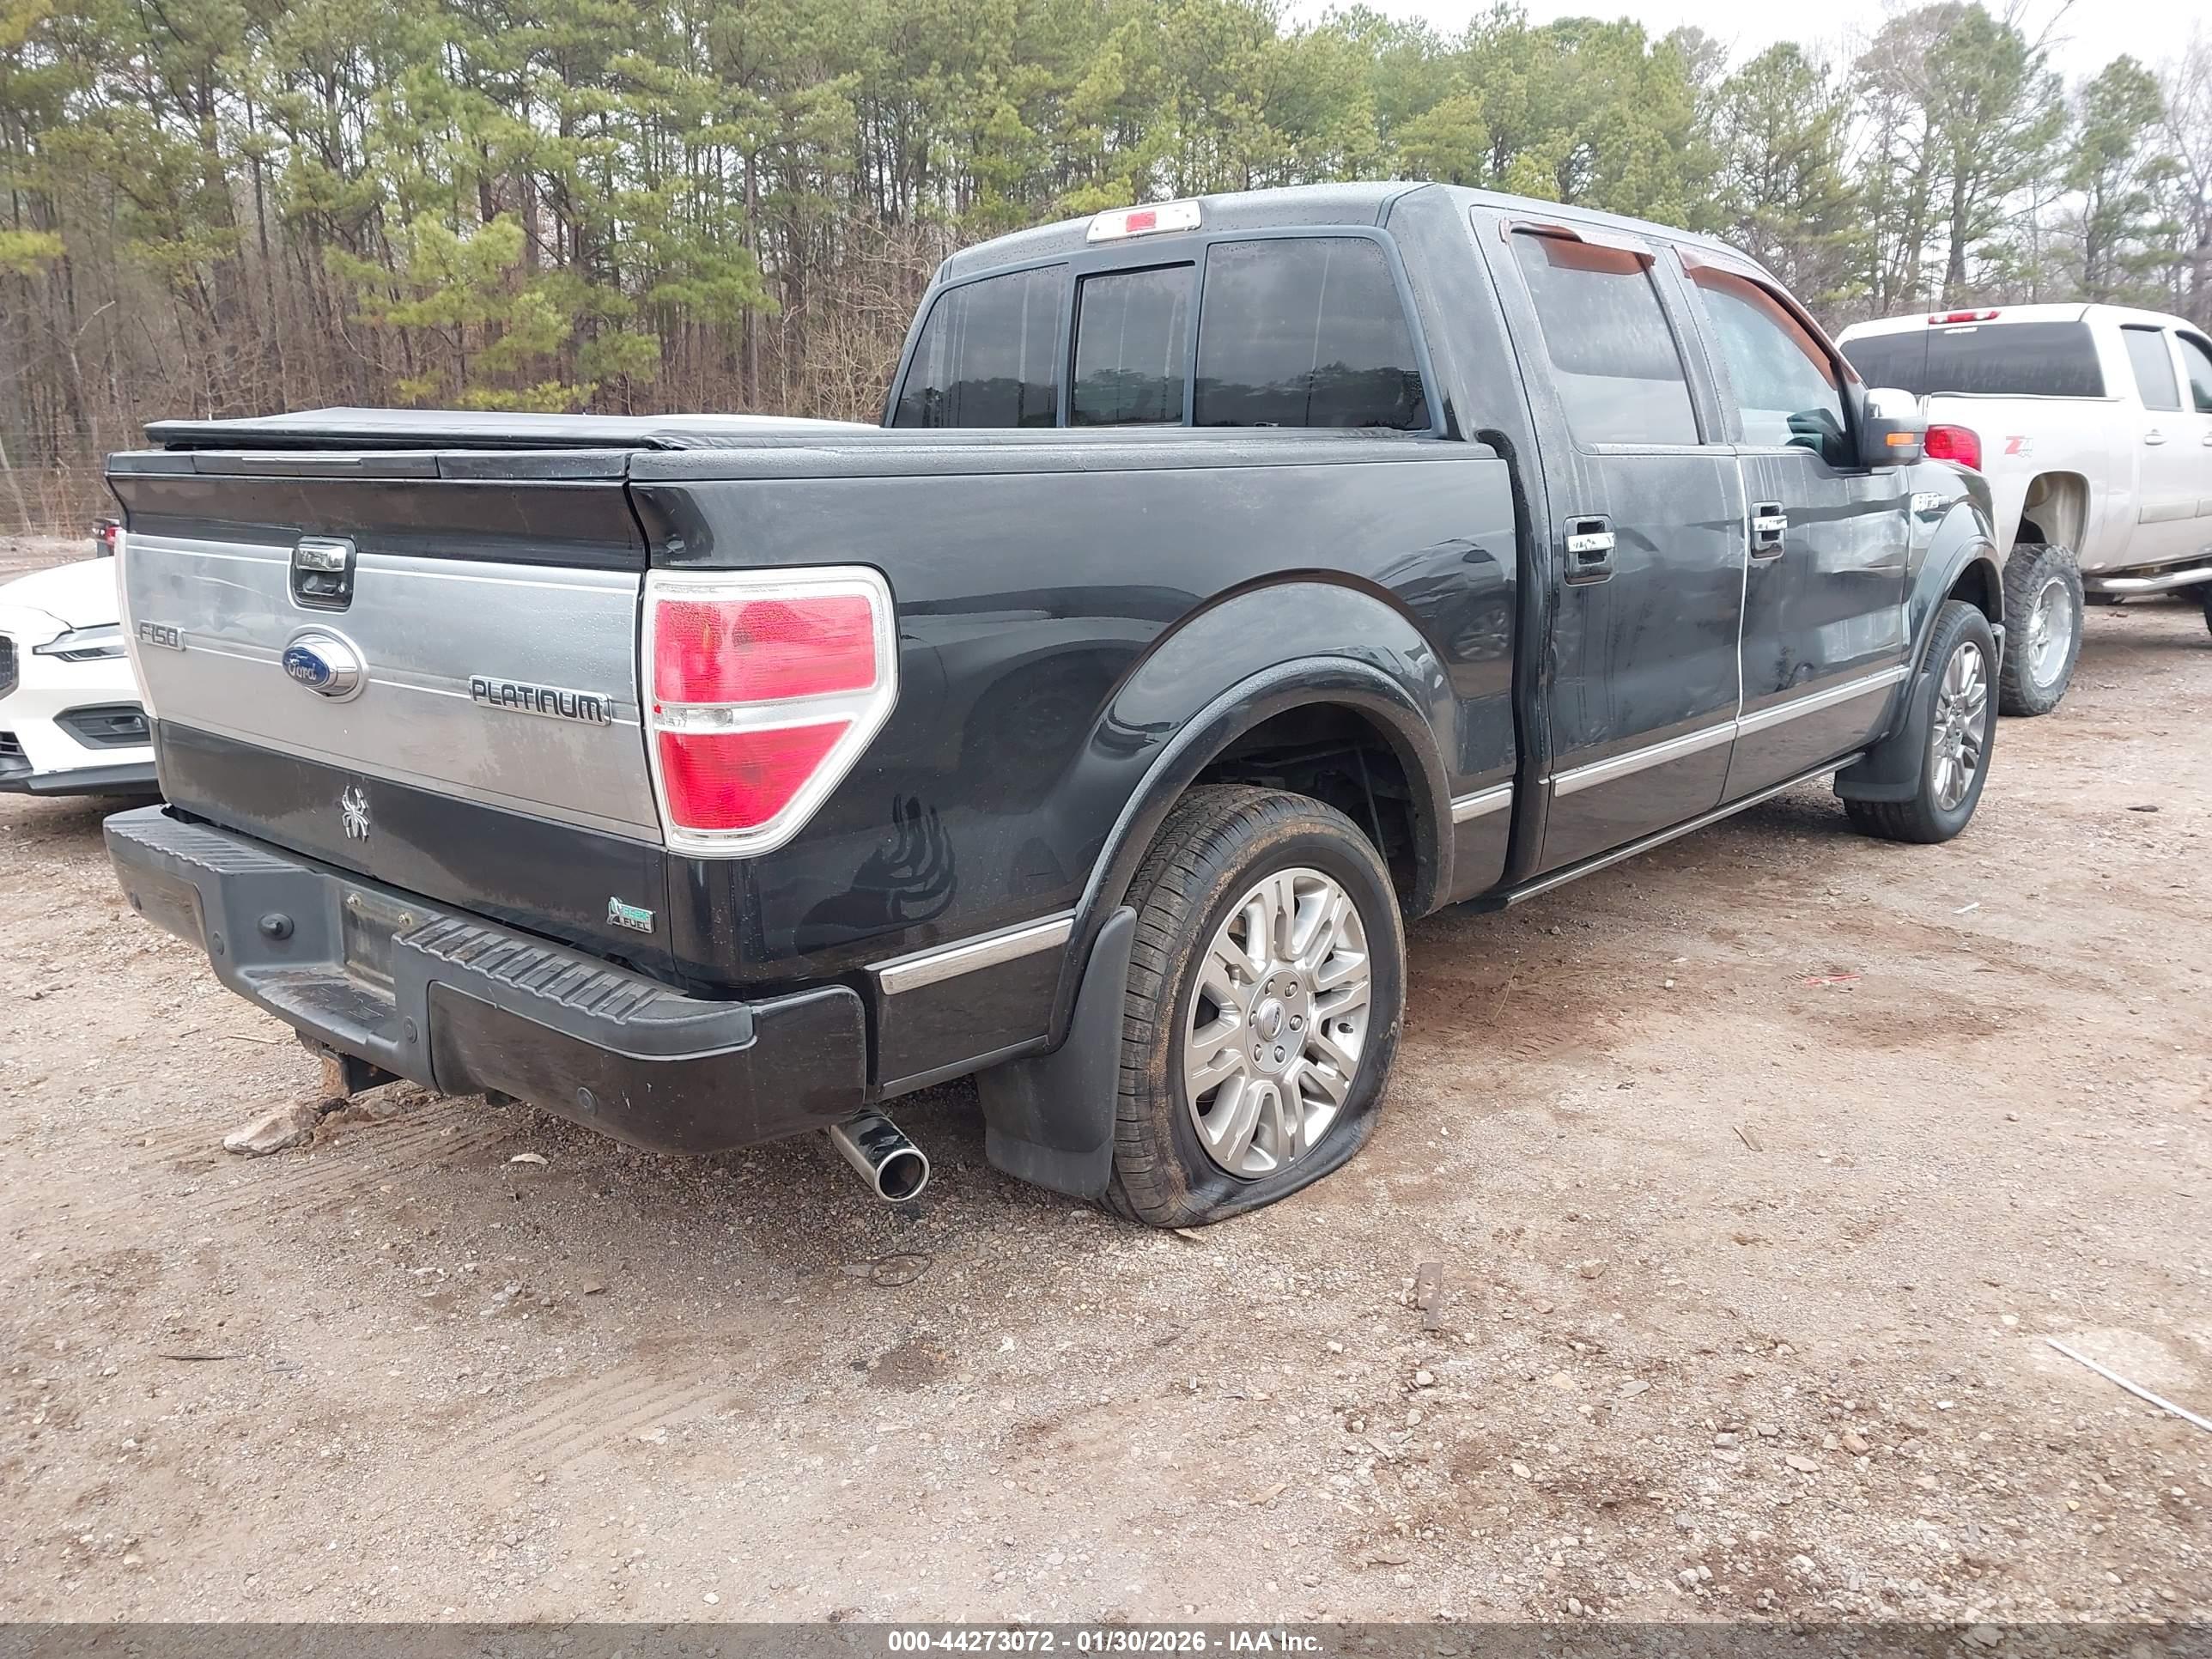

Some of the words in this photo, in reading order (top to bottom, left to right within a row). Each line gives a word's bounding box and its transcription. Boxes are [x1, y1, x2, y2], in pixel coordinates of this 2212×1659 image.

[284, 653, 317, 681] Ford
[471, 678, 603, 722] PLATINUM
[623, 917, 650, 932] FUEL
